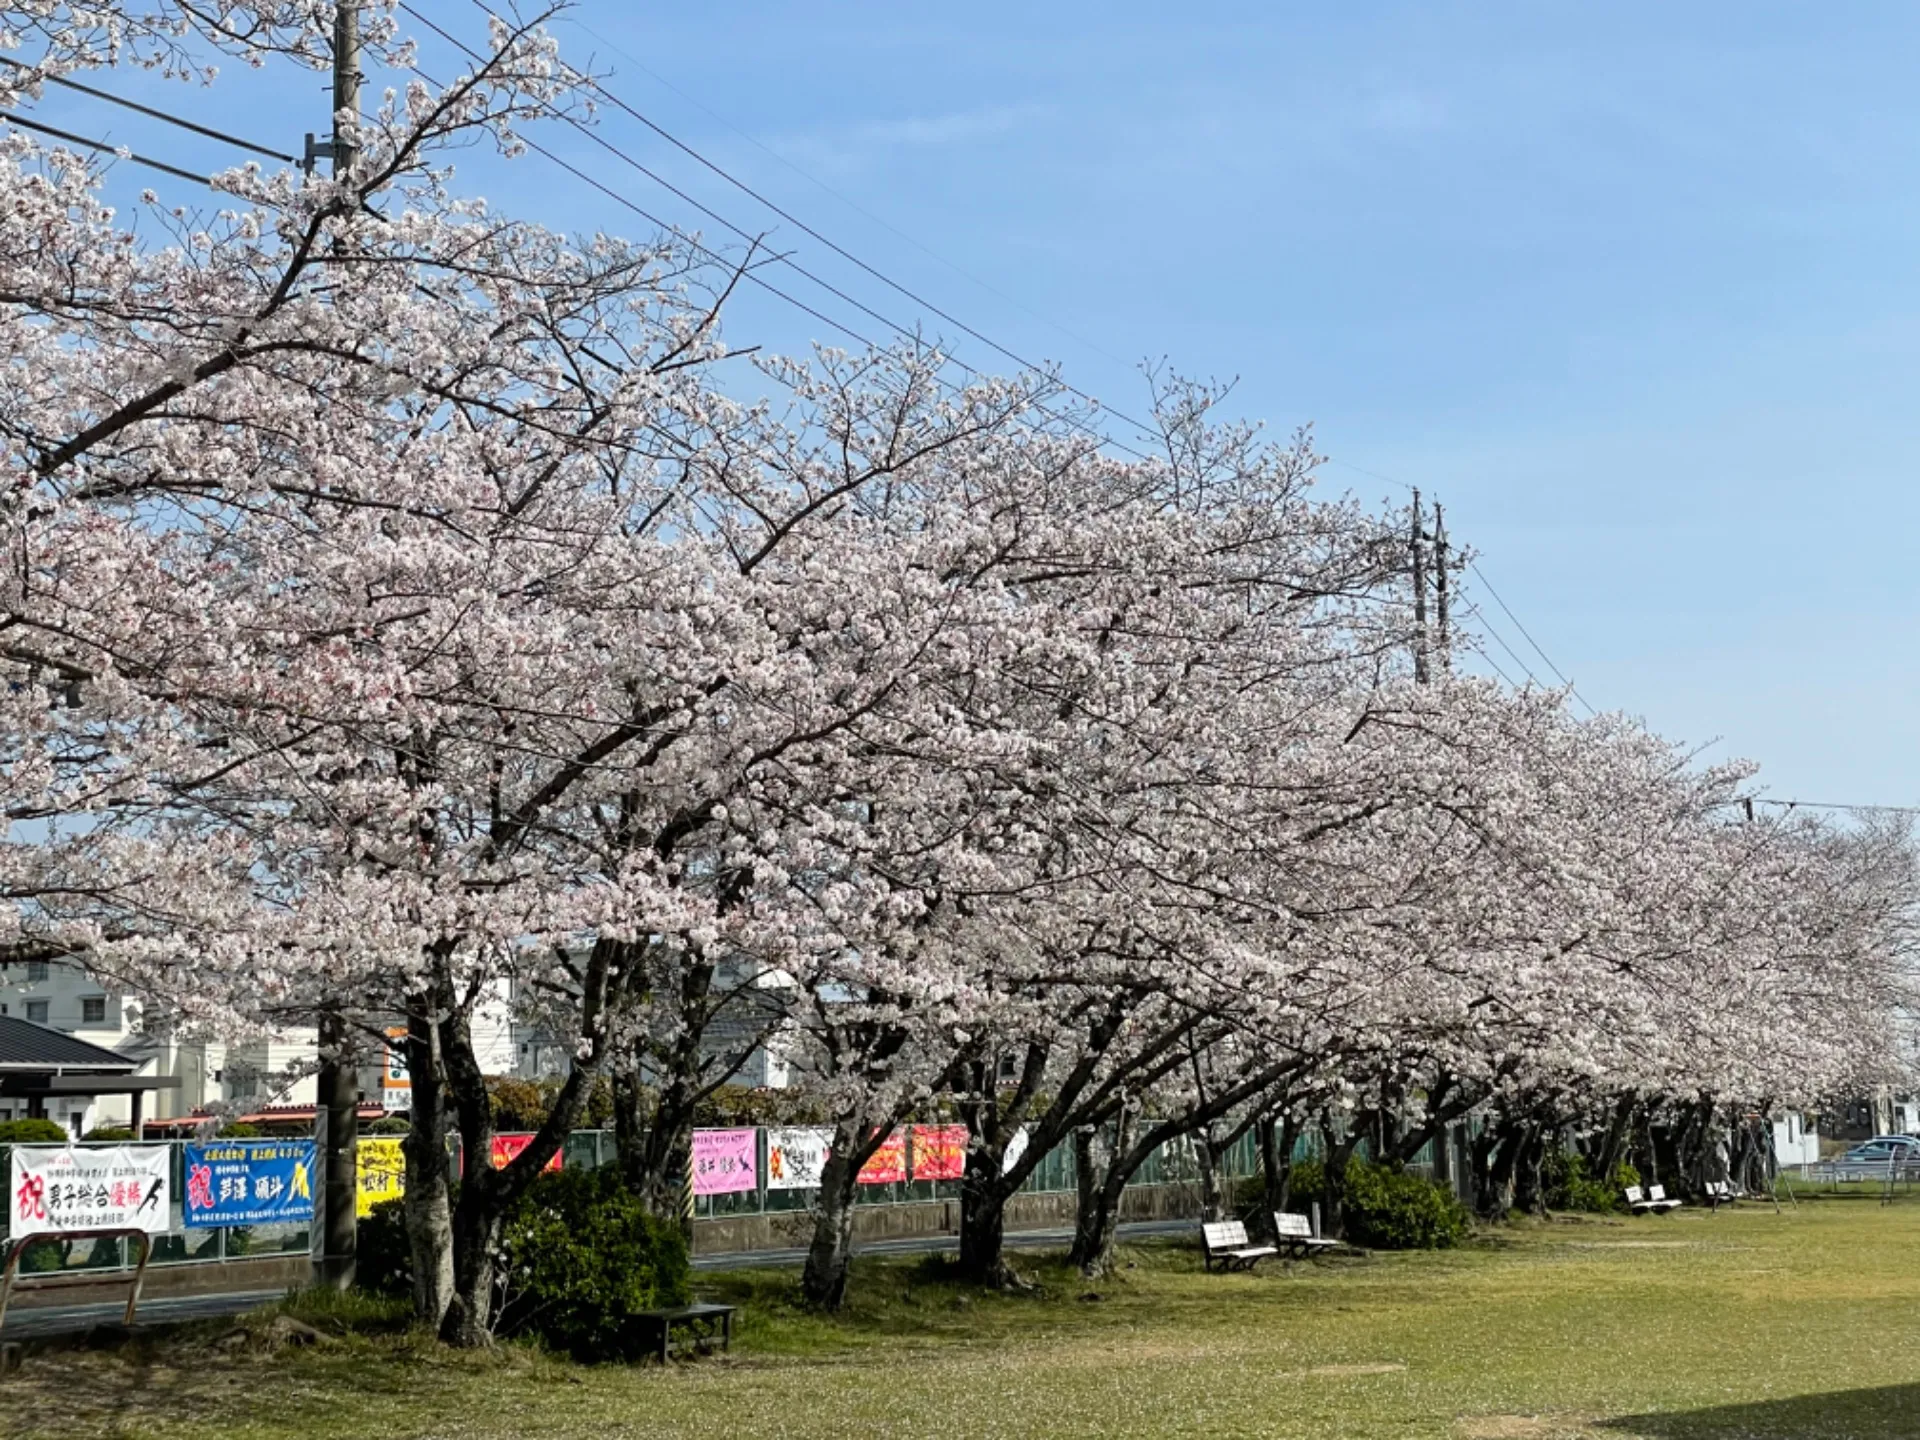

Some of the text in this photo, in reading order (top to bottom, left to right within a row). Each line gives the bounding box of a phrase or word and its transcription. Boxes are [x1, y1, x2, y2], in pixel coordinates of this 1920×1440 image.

[16, 1170, 45, 1221] 祝
[49, 1180, 141, 1211] 男子総合優勝
[188, 1163, 215, 1211] 祝
